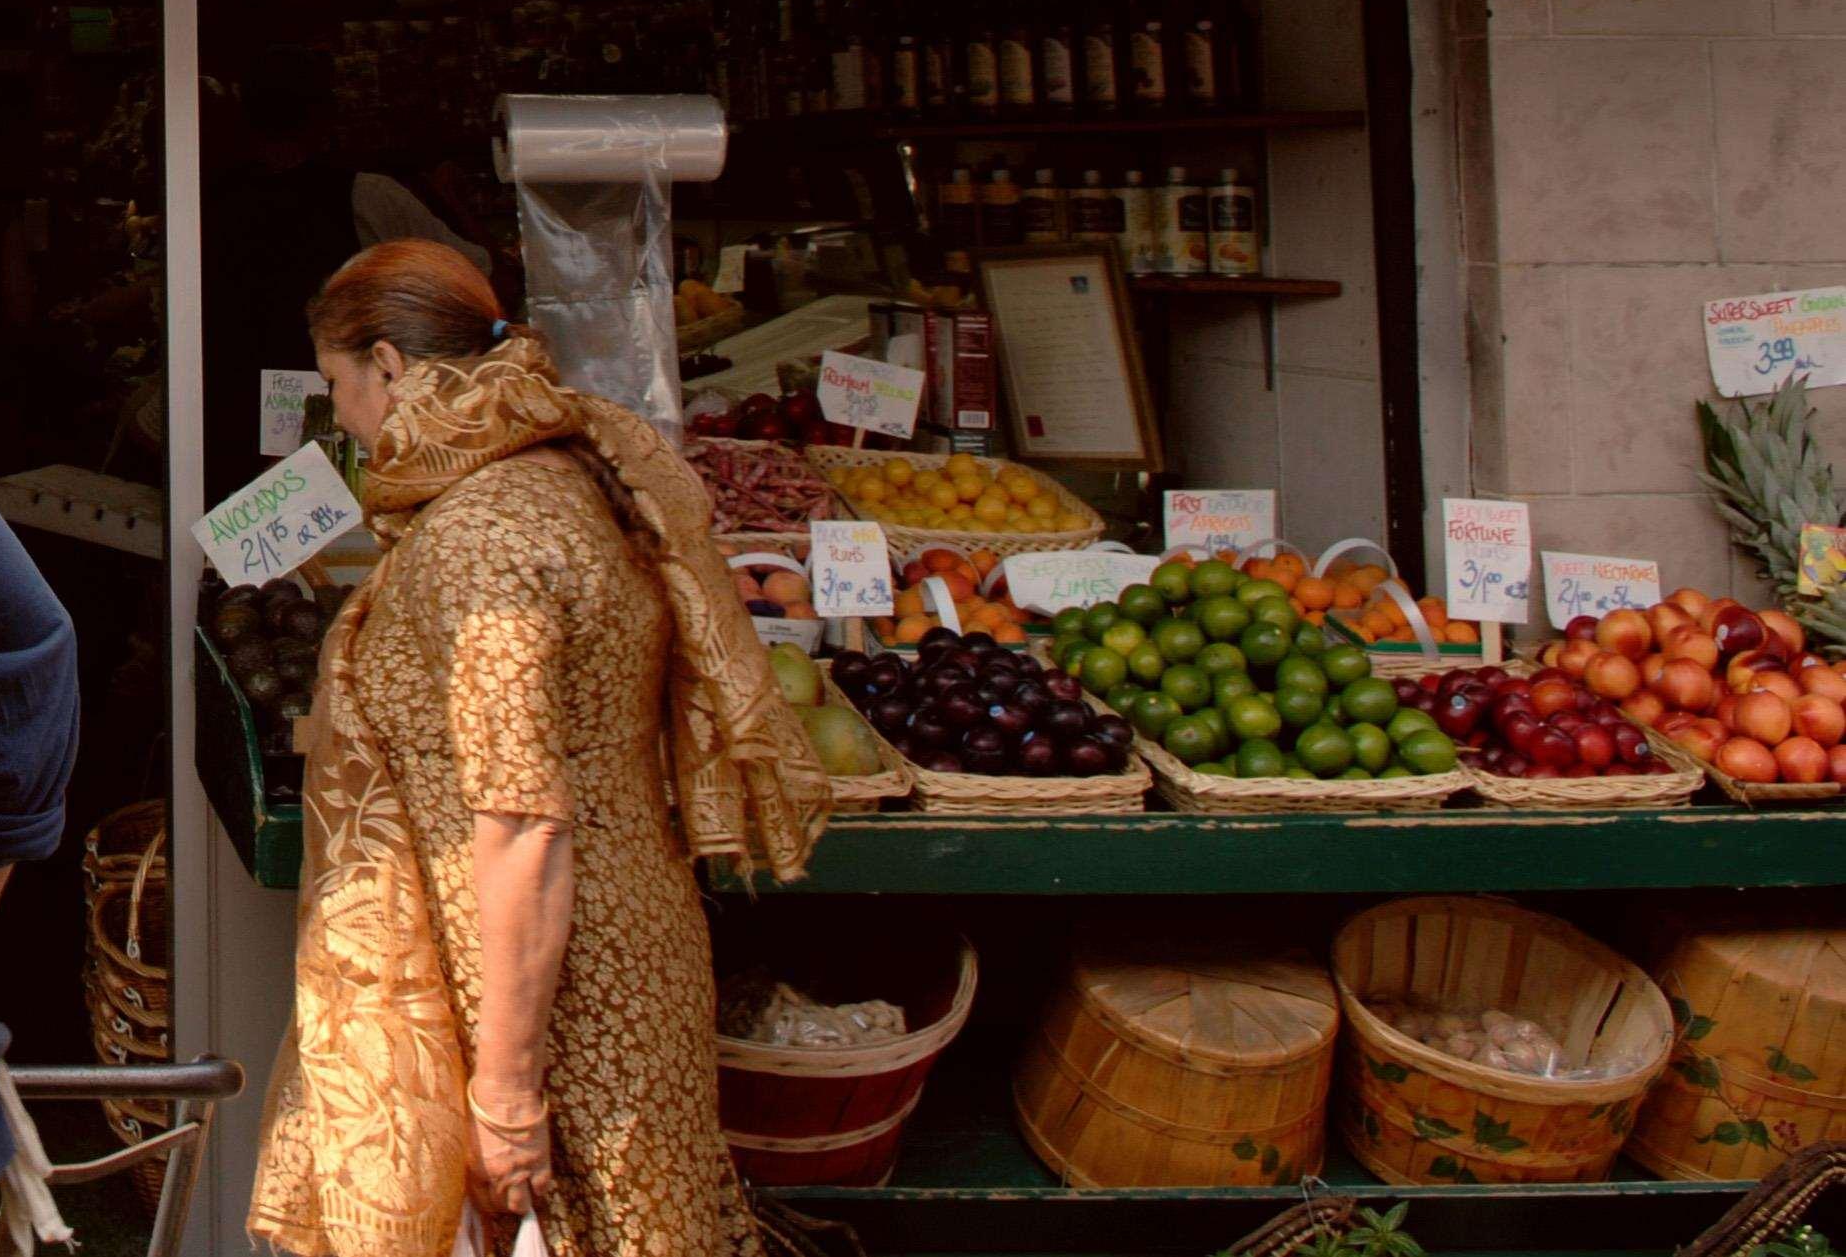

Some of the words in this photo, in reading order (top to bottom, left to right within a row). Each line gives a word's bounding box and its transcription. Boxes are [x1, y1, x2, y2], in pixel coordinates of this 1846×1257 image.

[208, 469, 307, 545] AVOCADOS
[1447, 520, 1518, 544] FORTUNE
[1050, 577, 1118, 601] LIMES
